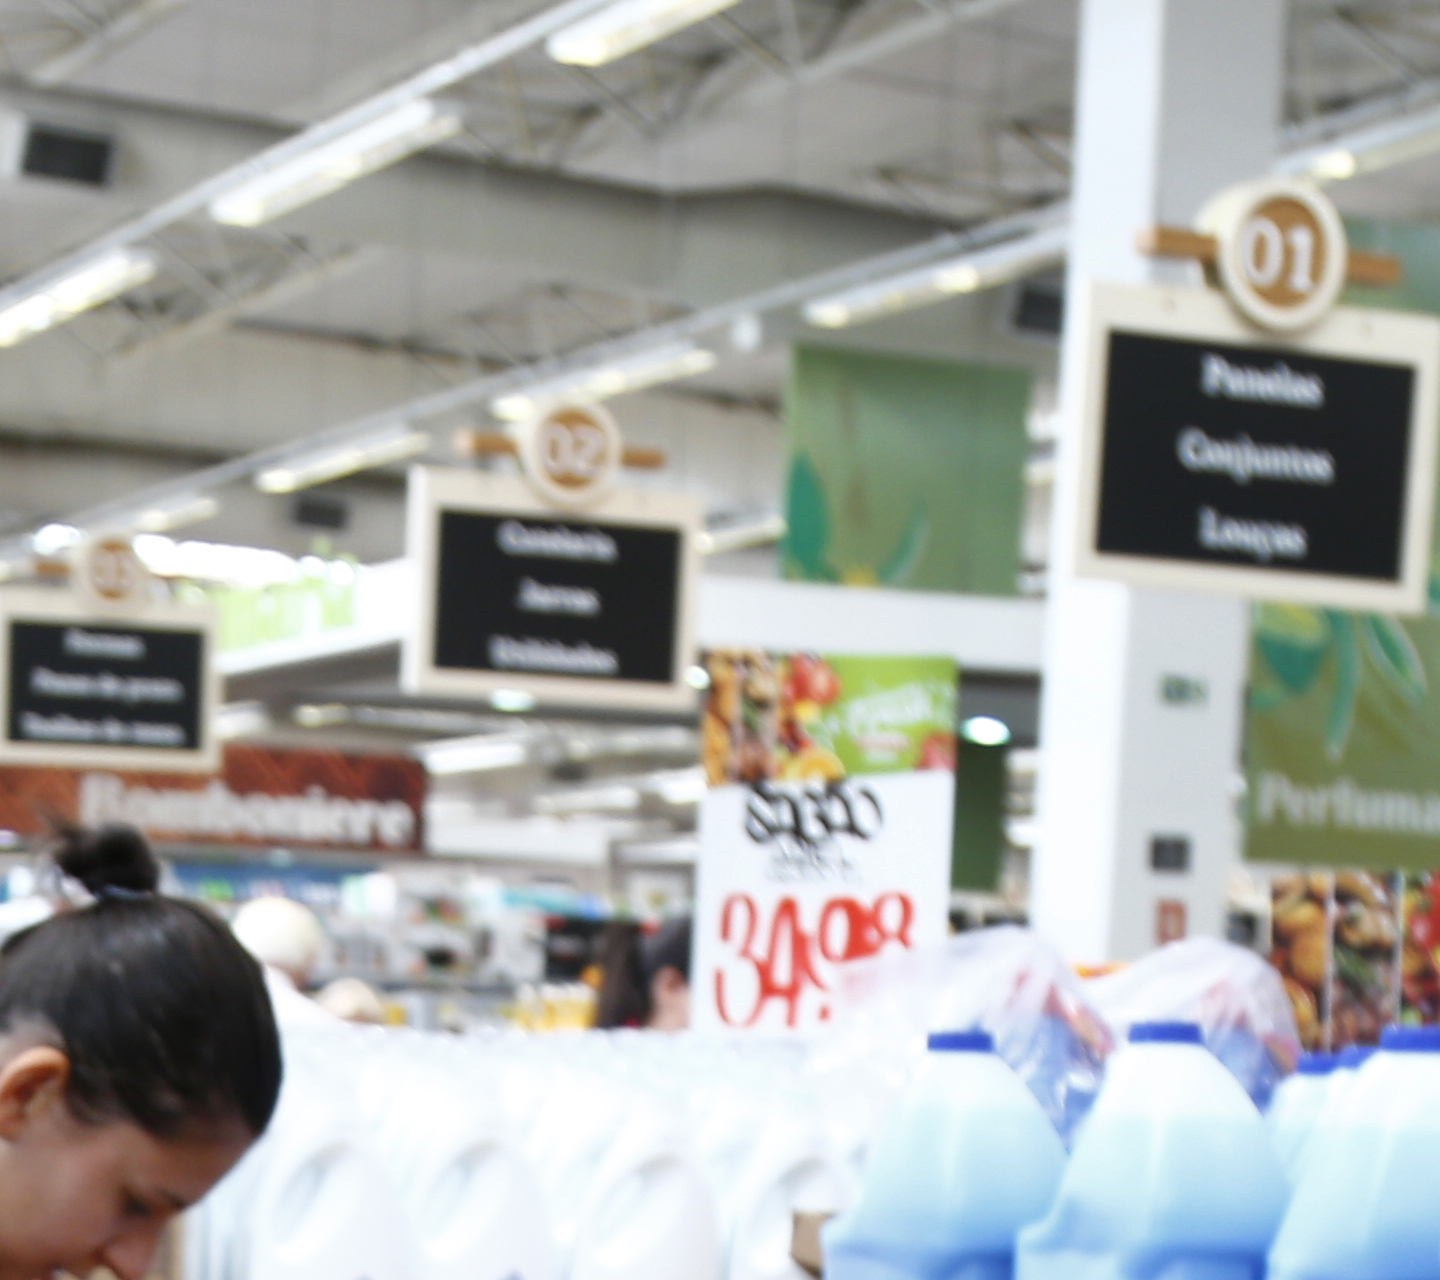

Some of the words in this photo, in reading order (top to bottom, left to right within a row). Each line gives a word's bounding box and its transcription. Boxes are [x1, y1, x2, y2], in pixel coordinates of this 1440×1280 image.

[1240, 217, 1317, 293] 01
[1202, 355, 1324, 408] Panelas
[540, 422, 603, 475] 02
[1178, 428, 1334, 484] Conjuntos
[1199, 508, 1308, 561] Louças
